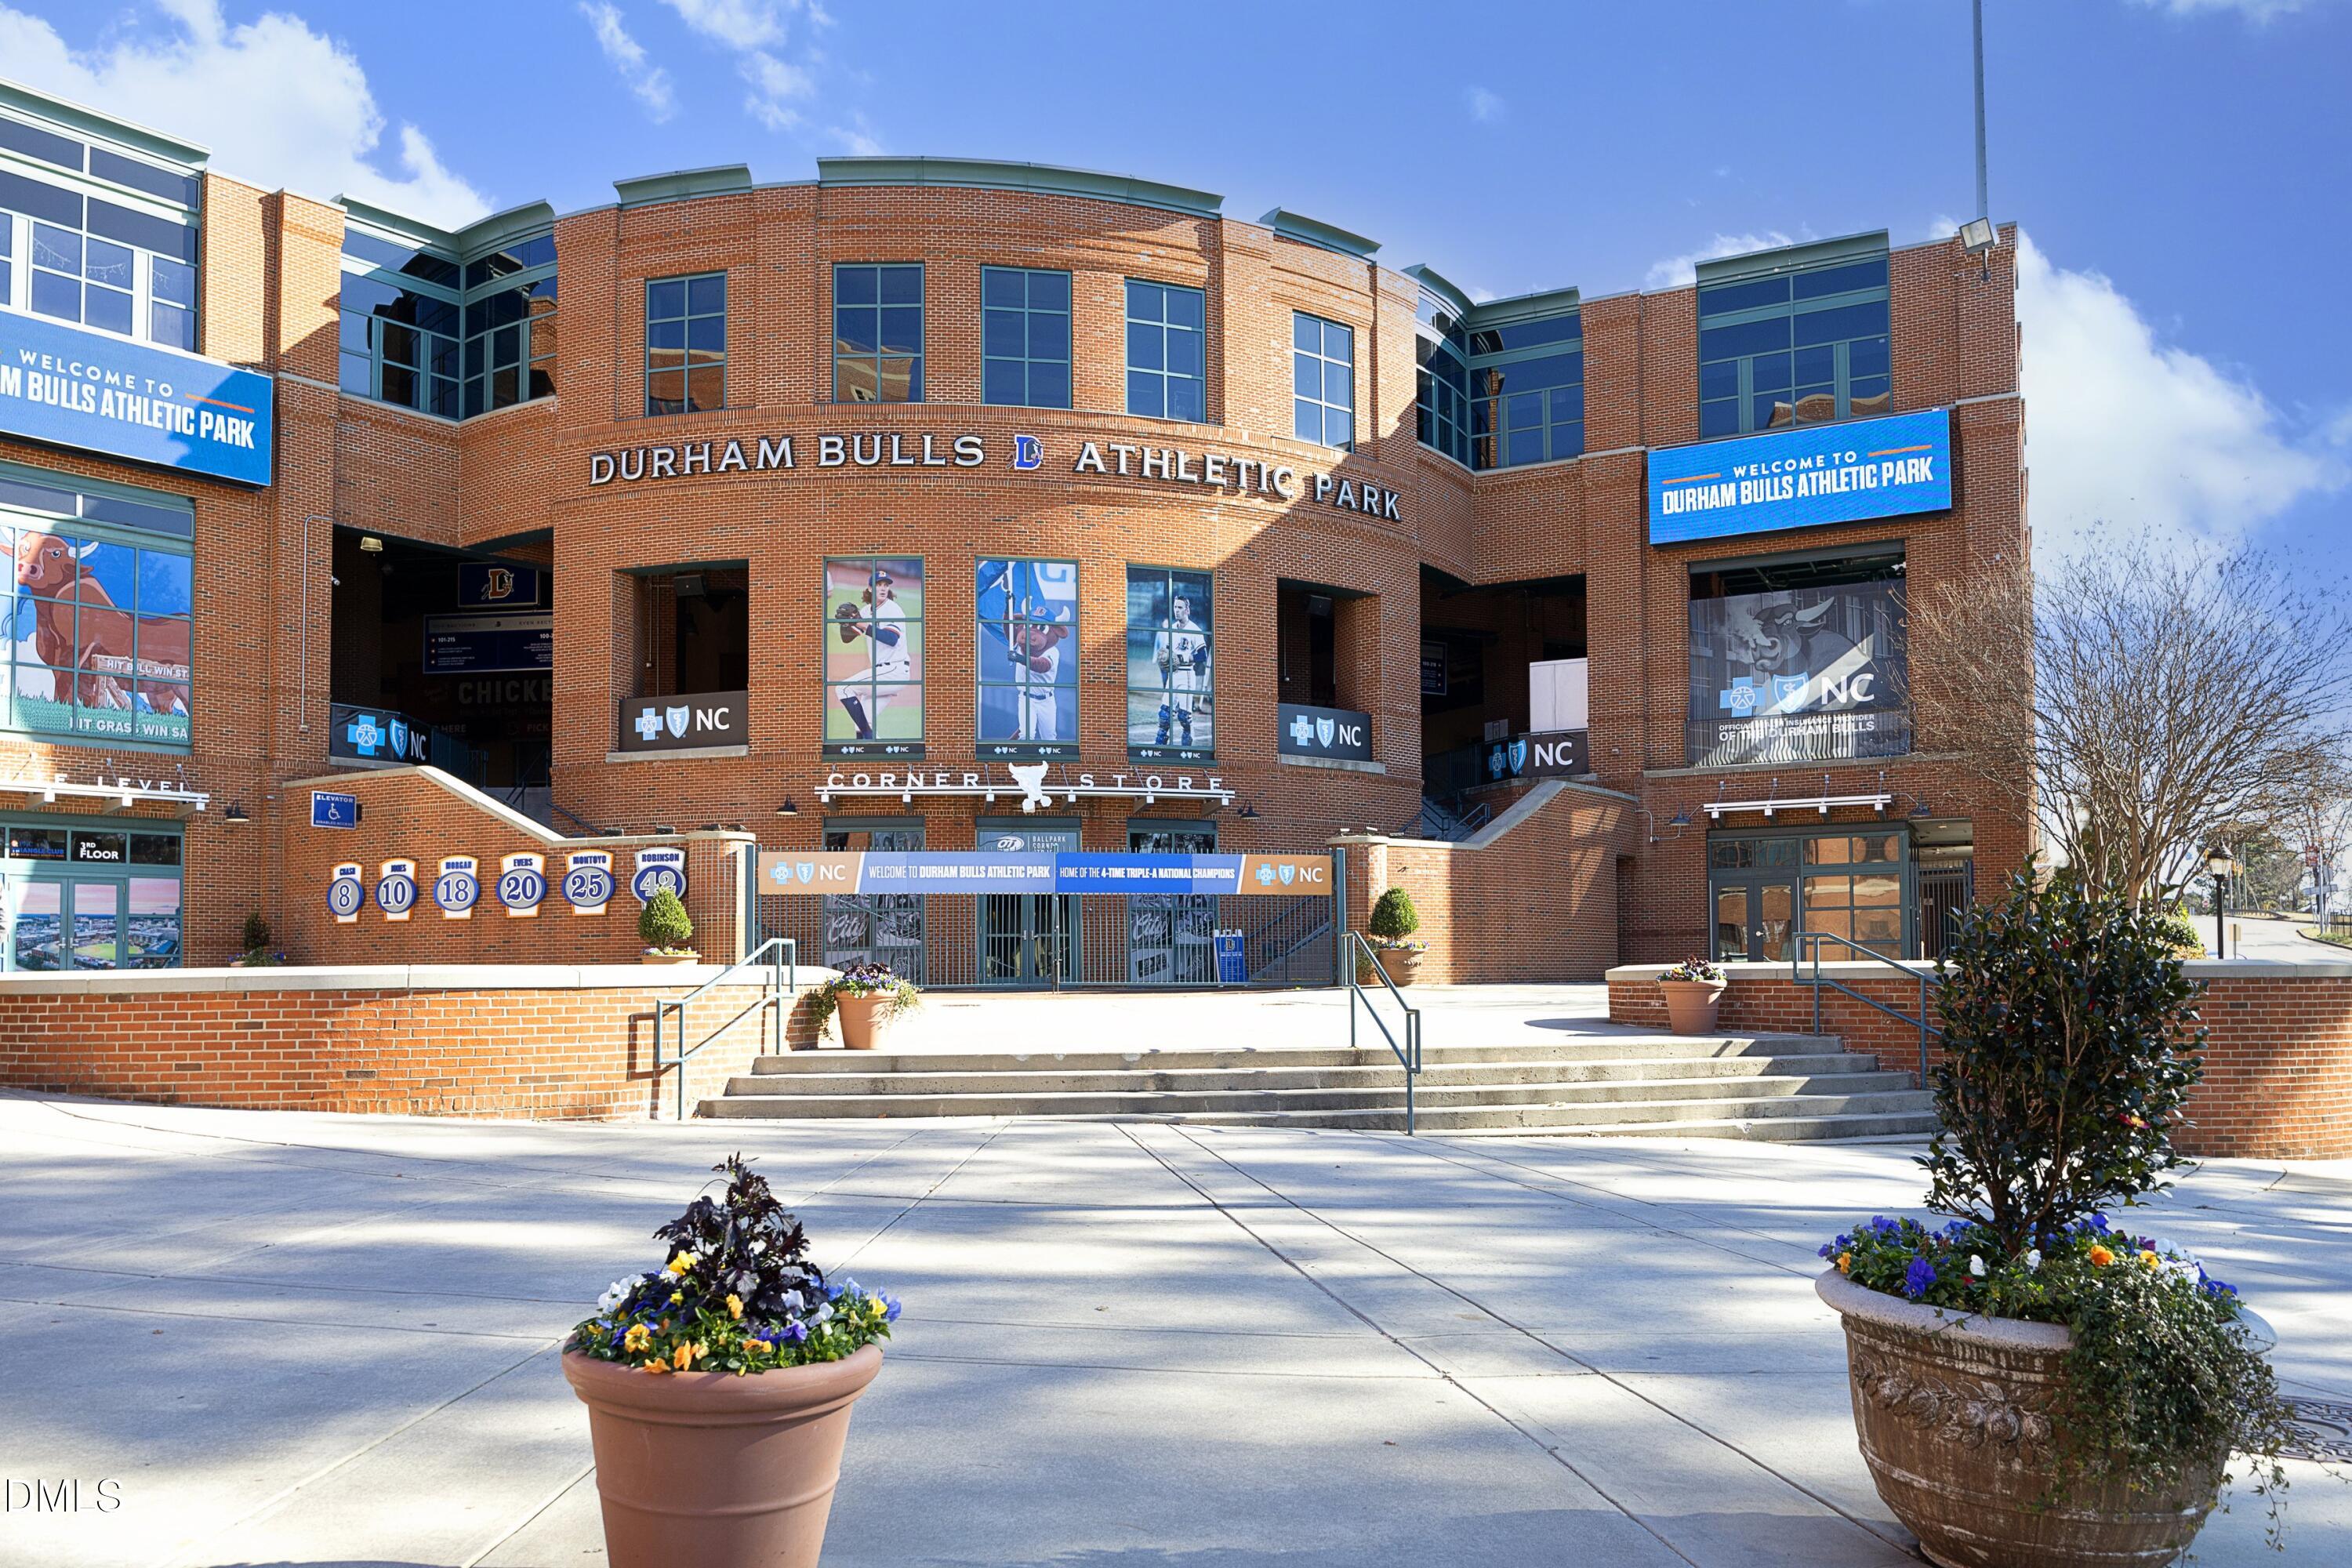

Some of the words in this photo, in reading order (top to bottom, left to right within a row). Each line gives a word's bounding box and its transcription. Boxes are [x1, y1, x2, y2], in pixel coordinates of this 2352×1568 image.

[20, 349, 135, 390] WELCOME
[145, 379, 173, 398] TO
[27, 371, 96, 414] BULLS
[100, 388, 195, 435] ATHLETIC
[200, 410, 255, 449] PARK
[1733, 456, 1825, 479] WELCOME
[1832, 451, 1857, 466] TO
[588, 436, 796, 486] DURHAM
[817, 434, 985, 468] BULLS
[1074, 441, 1294, 499] ATHLETIC
[1312, 470, 1403, 522] PARK
[1662, 483, 1736, 515] DURHAM
[1740, 475, 1795, 506] BULLS
[1797, 463, 1878, 498] ATHLETIC
[1882, 456, 1933, 487] PARK
[107, 659, 124, 670] HIT
[154, 666, 172, 677] WIN
[1821, 673, 1875, 705] NC
[69, 717, 93, 730] HIT
[142, 724, 168, 736] WIN
[172, 728, 188, 739] SA
[696, 706, 730, 731] NC
[1786, 716, 1832, 727] INSURANCE
[1338, 724, 1362, 747] NC
[1719, 731, 1736, 742] OF
[1768, 724, 1828, 739] DURHAM
[1831, 720, 1875, 735] BULLS
[411, 731, 426, 760] NC
[1534, 742, 1573, 767] NC
[827, 773, 979, 787] CORNER
[1080, 773, 1222, 791] STORE
[316, 794, 354, 804] ELEVATOR
[80, 842, 96, 851] 3RD
[80, 850, 118, 860] FLOOR
[641, 853, 680, 862] ROBINSON
[445, 861, 473, 869] MORGAN
[514, 858, 533, 867] EVERS
[573, 855, 607, 865] MONTOYO
[819, 865, 846, 880] NC
[869, 866, 906, 879] WELCOME
[908, 866, 918, 879] TO
[919, 865, 957, 879] DURHAM
[959, 866, 985, 879] BULLS
[987, 866, 1025, 879] ATHLETIC
[1026, 866, 1051, 879] PARK
[1060, 867, 1079, 878] HOME
[1080, 867, 1088, 878] OF
[1089, 867, 1101, 878] THE
[1101, 867, 1126, 879] 4-TIME
[1126, 868, 1157, 879] TRIPLE-A
[1158, 868, 1192, 879] NATIONAL
[1192, 868, 1235, 879] CHAMPIONS
[1299, 867, 1323, 883] NC
[382, 880, 407, 906] 10
[441, 877, 470, 903] 18
[506, 874, 538, 902] 20
[570, 873, 605, 899] 25
[639, 870, 677, 897] 42
[338, 883, 350, 908] 8
